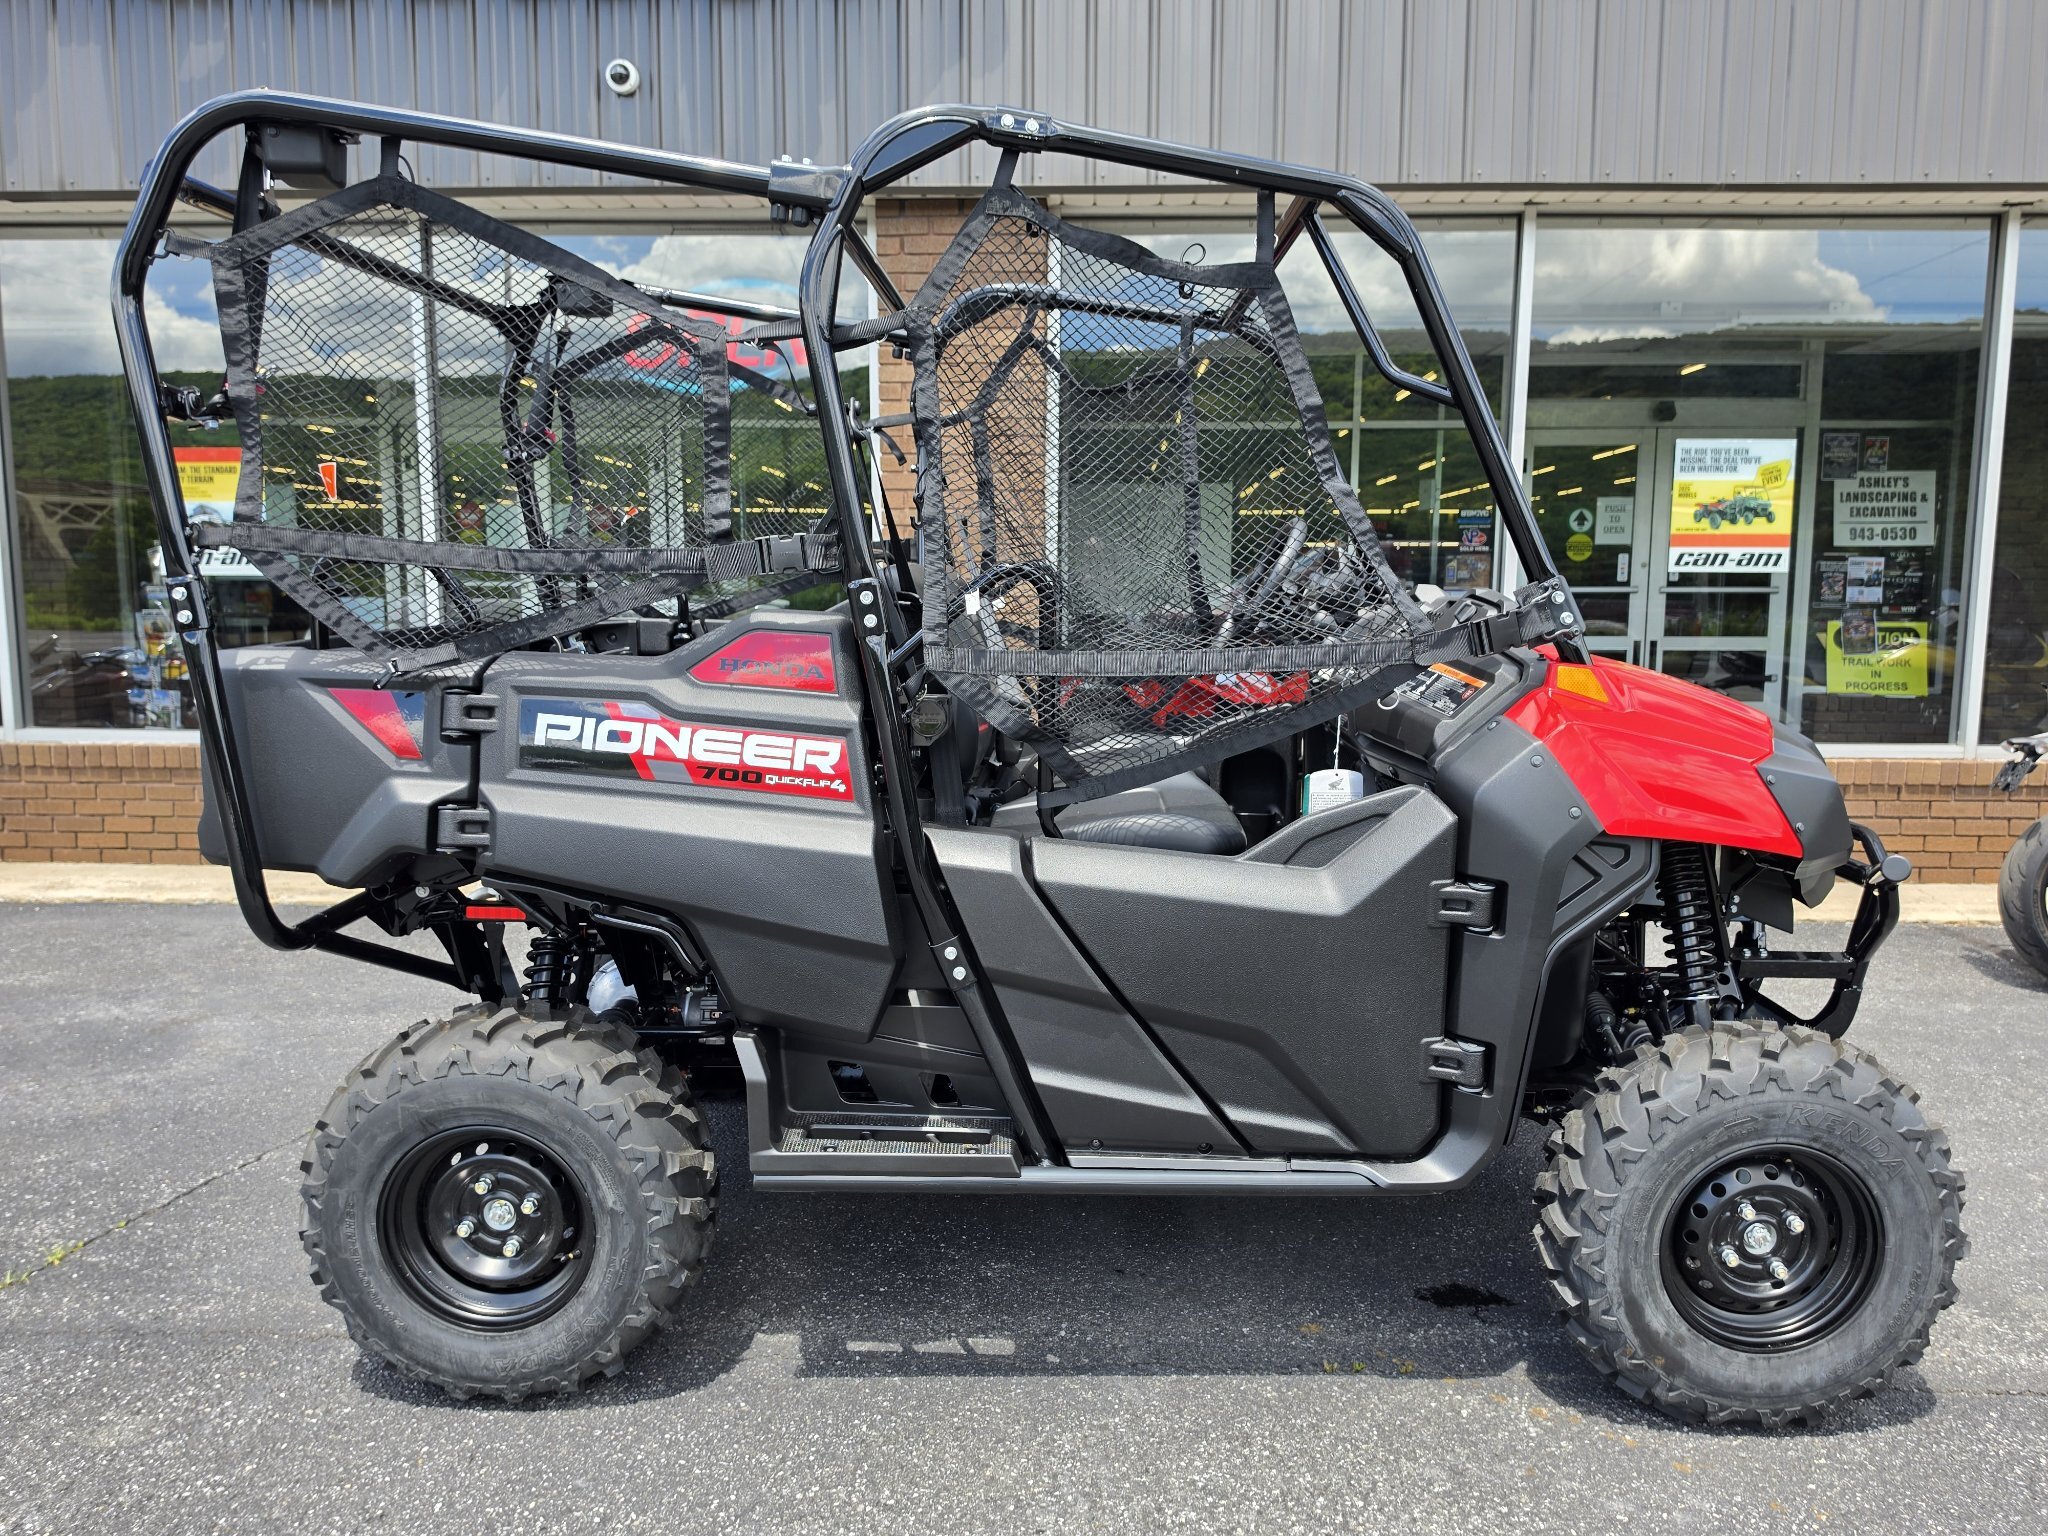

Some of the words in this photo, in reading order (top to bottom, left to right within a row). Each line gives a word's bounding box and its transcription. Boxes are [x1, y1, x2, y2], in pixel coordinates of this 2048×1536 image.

[1681, 448, 1692, 456] THE
[1695, 448, 1708, 456] RIDE
[1710, 448, 1731, 456] YOU'VE
[1734, 448, 1749, 456] BEEN
[1710, 456, 1721, 464] THE
[1724, 456, 1738, 464] DEAL
[1740, 456, 1761, 464] YOU'VE
[190, 466, 201, 474] THE
[204, 466, 237, 474] STANDARD
[1680, 465, 1695, 473] BEEN
[1697, 465, 1724, 473] WAITING
[187, 475, 214, 483] TERRAIN
[1762, 474, 1783, 487] EVENT
[1858, 476, 1909, 488] ASHLEY'S
[1839, 491, 1917, 503] LANDSCAPING
[1920, 493, 1928, 503] &
[1604, 504, 1626, 513] PUSH
[1849, 506, 1917, 518] EXCAVATING
[1609, 515, 1621, 523] TO
[1603, 526, 1625, 534] OPEN
[1849, 527, 1917, 541] 943-0530
[1674, 552, 1783, 567] can-am
[1877, 632, 1914, 646] TION
[1842, 657, 1874, 667] TRAIL
[719, 657, 825, 680] HONDA
[1871, 670, 1881, 678] IN
[1845, 682, 1908, 692] PROGRESS
[534, 712, 843, 774] PIONEER
[696, 765, 763, 784] 700
[1786, 1104, 1906, 1179] KENDA
[494, 1306, 609, 1376] KENDA
